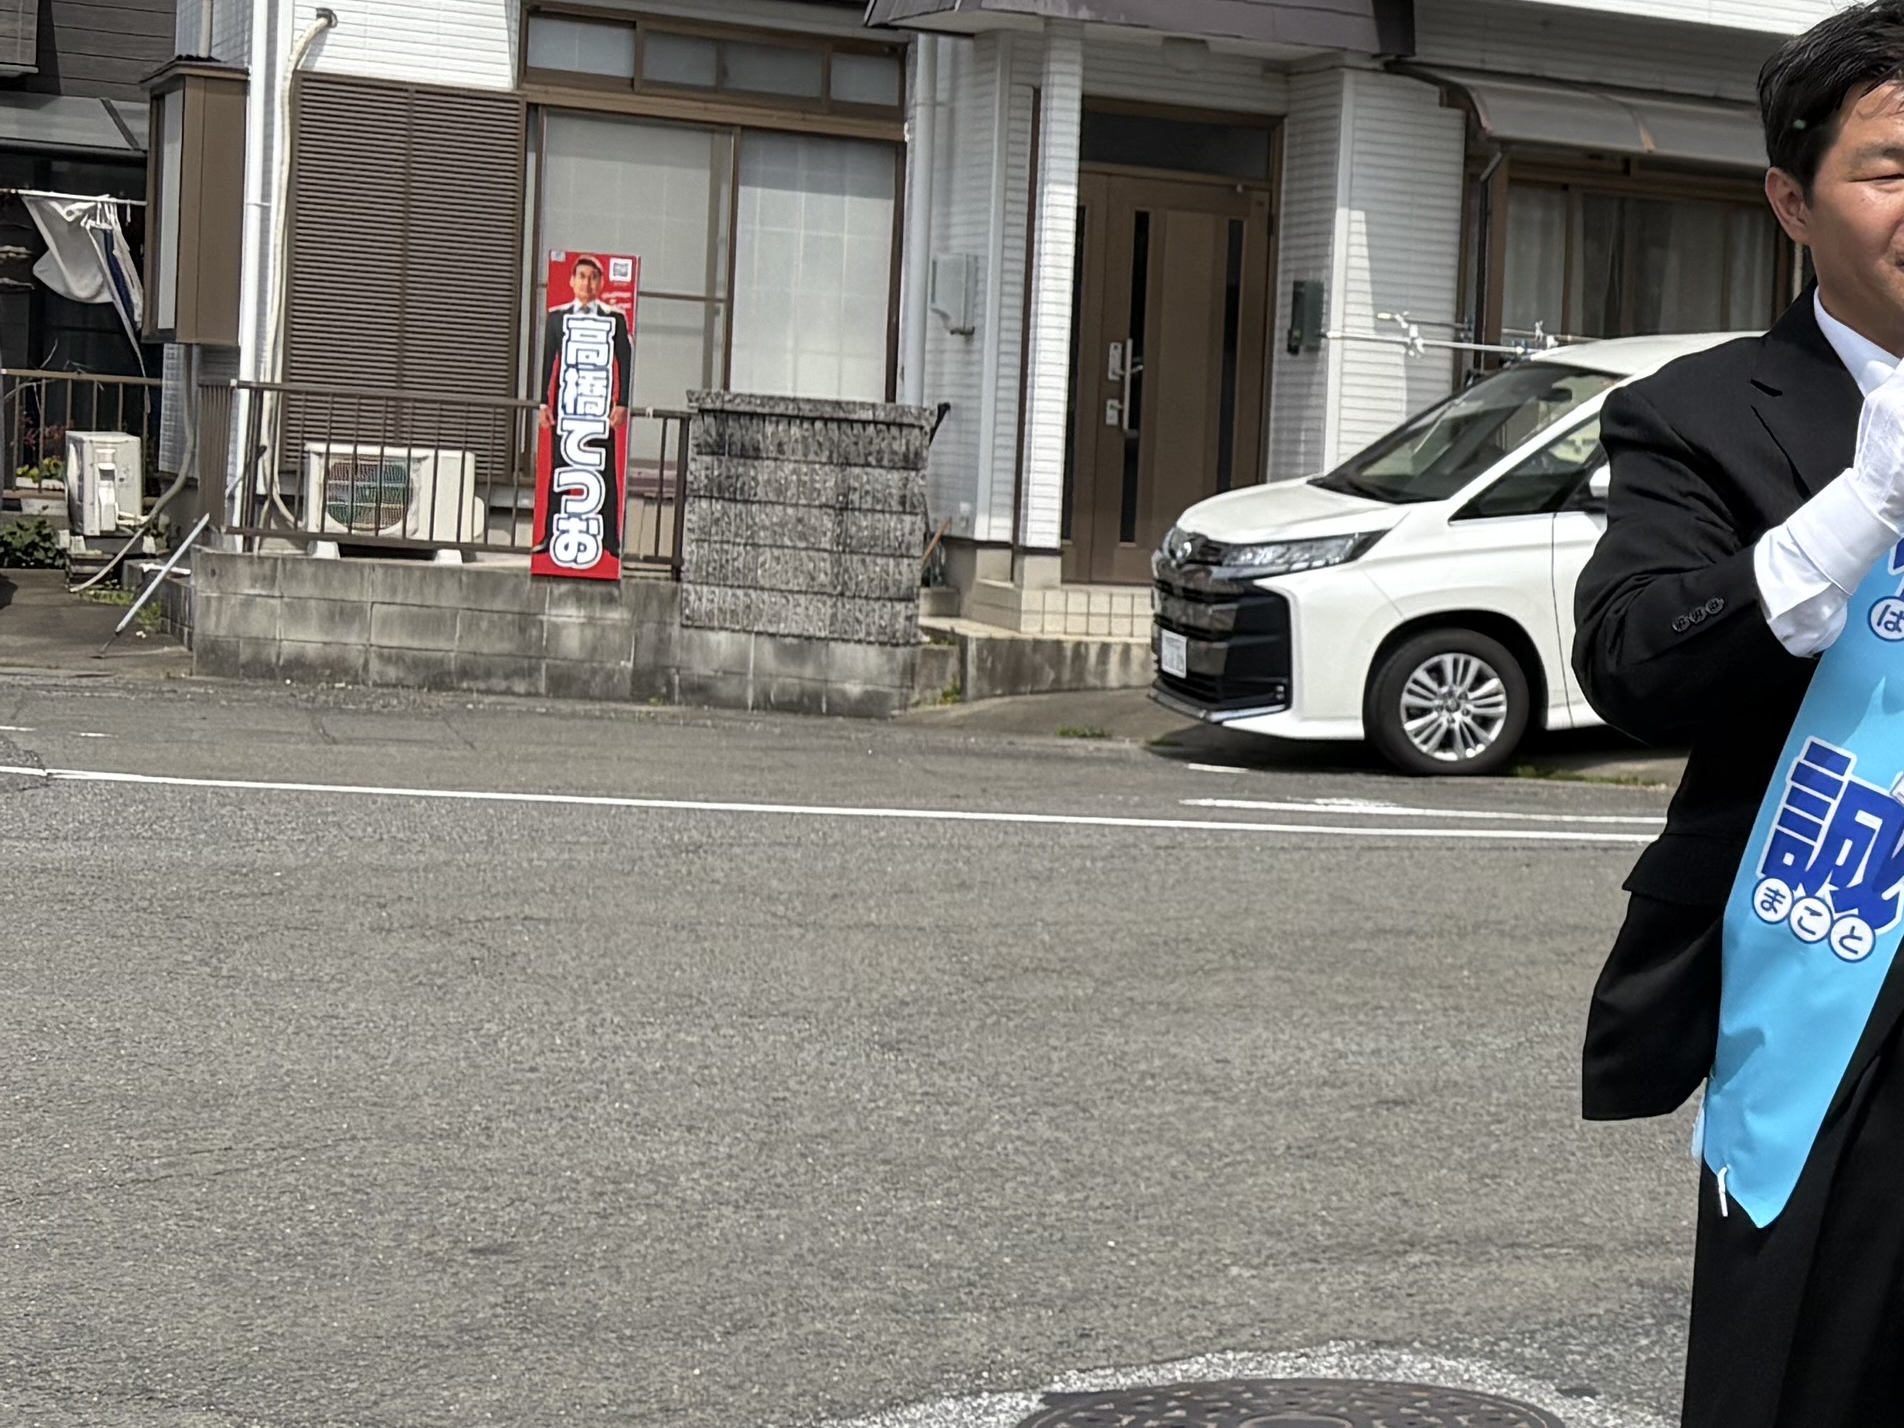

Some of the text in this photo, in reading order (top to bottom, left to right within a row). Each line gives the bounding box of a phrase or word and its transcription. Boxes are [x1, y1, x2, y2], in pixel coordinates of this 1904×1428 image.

[551, 316, 614, 568] 高橋てつお
[1756, 881, 1869, 959] まこと
